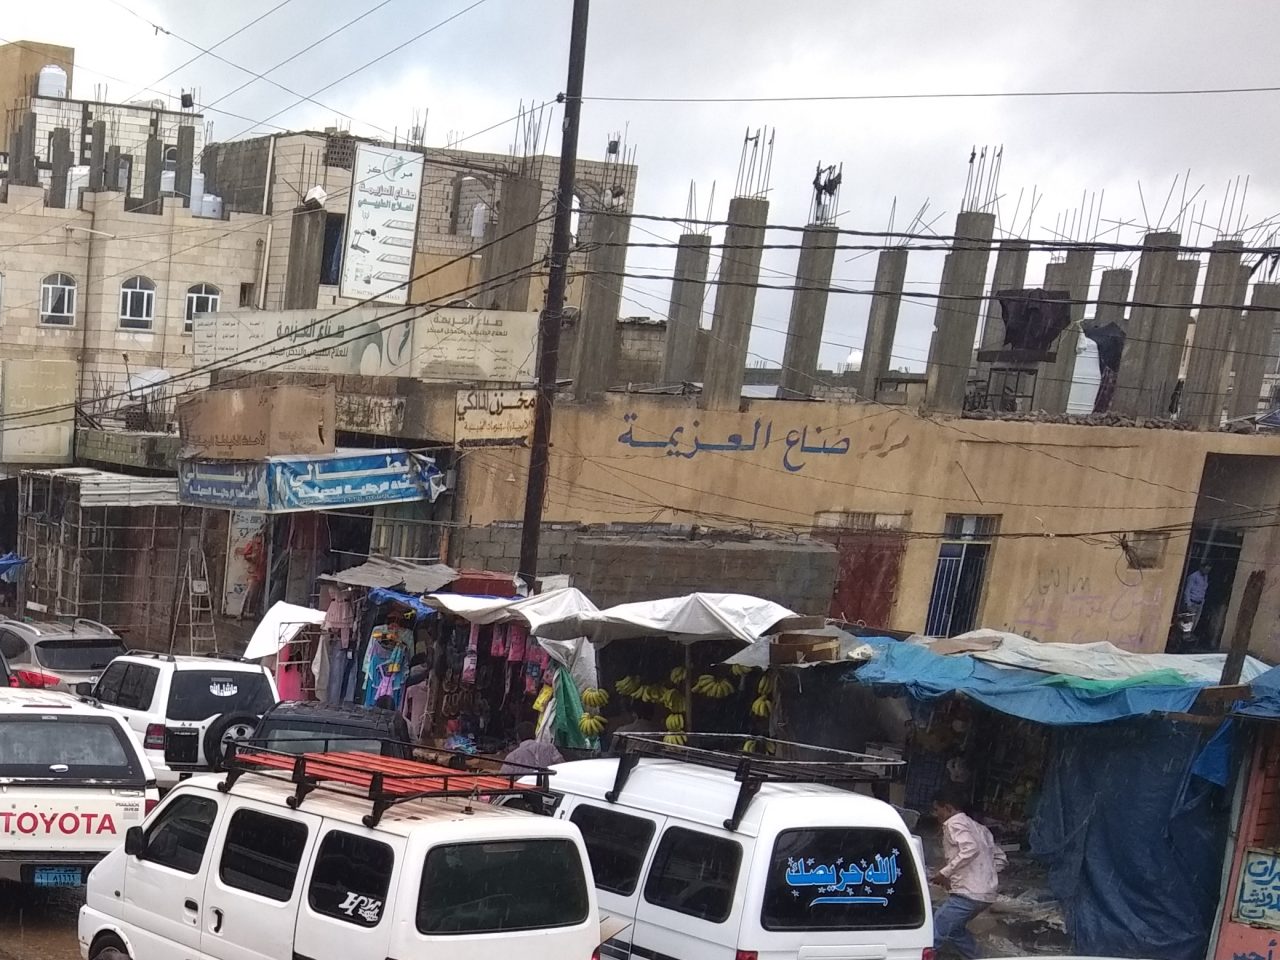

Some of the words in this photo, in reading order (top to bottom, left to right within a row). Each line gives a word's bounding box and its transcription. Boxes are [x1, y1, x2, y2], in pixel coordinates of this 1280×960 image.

[457, 388, 489, 421] المالكي
[489, 392, 536, 416] مخزن
[618, 412, 773, 460] العزيمة
[783, 424, 851, 472] صناع
[0, 812, 117, 835] TOYOTA
[865, 853, 898, 885] الله
